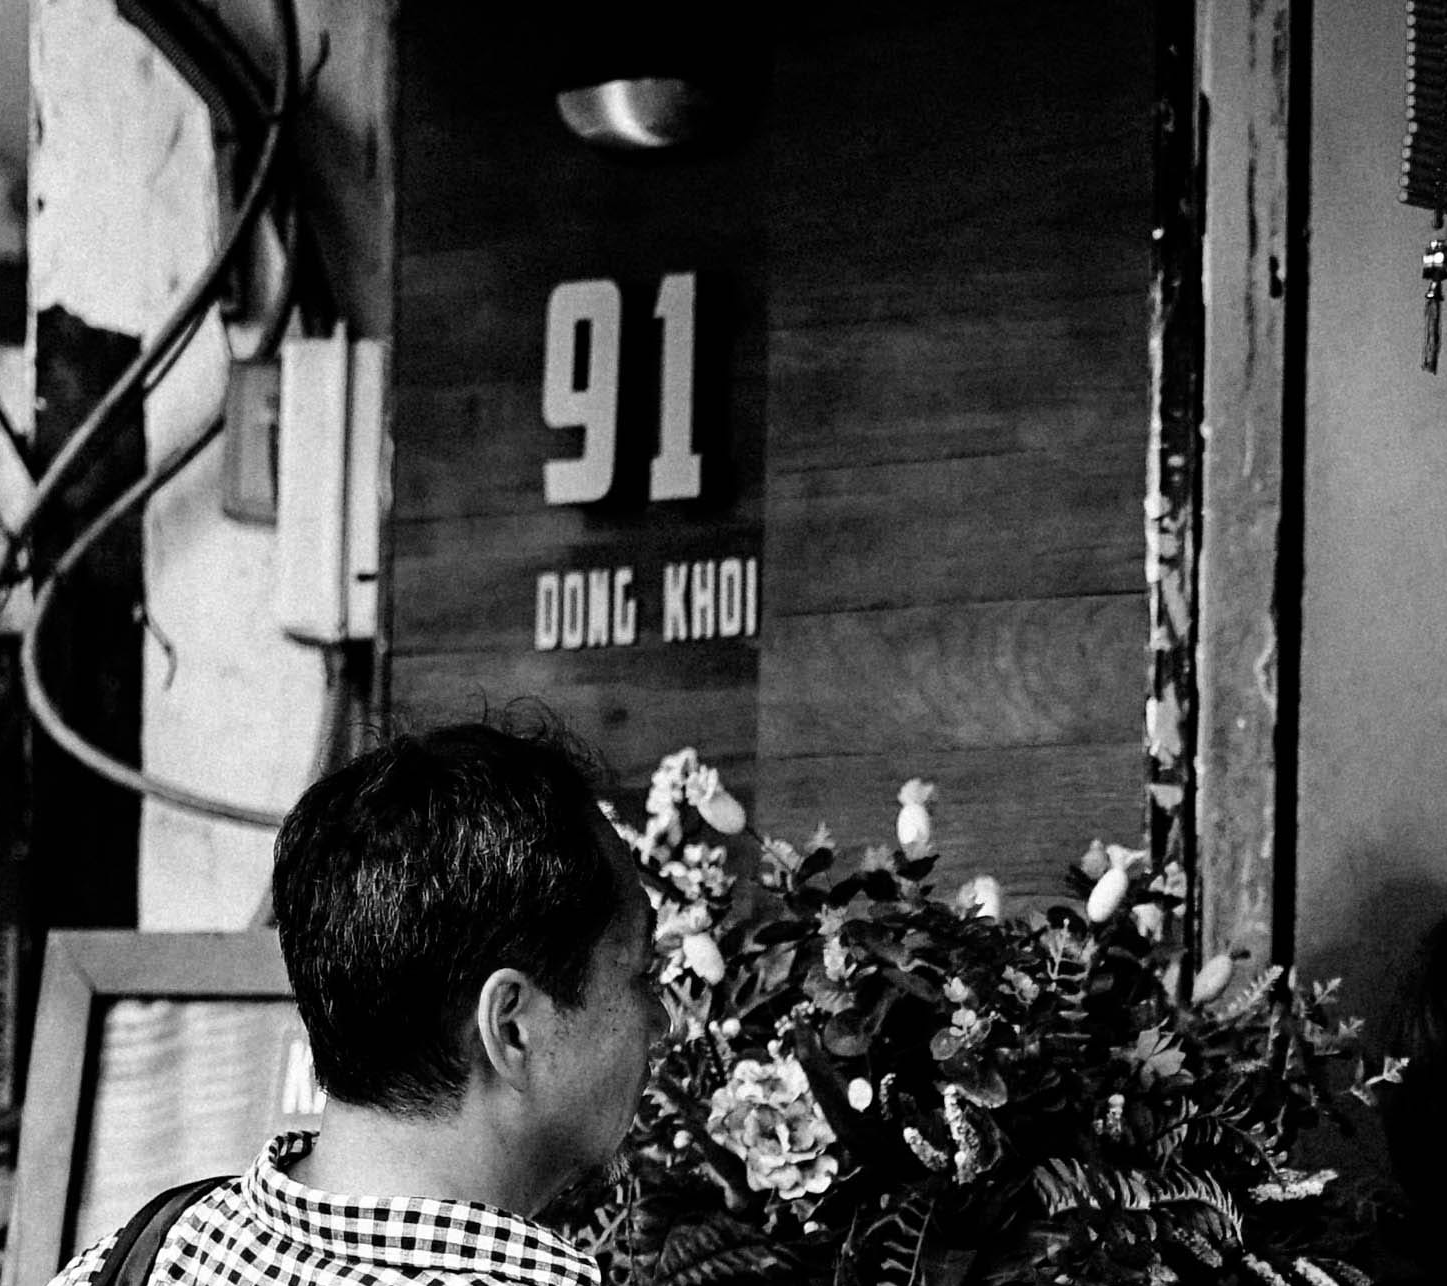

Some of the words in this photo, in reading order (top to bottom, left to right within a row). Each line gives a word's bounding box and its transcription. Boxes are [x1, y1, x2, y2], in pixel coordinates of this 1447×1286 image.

[543, 271, 703, 504] 91
[534, 567, 637, 651] DONG
[663, 558, 758, 645] KHOI
